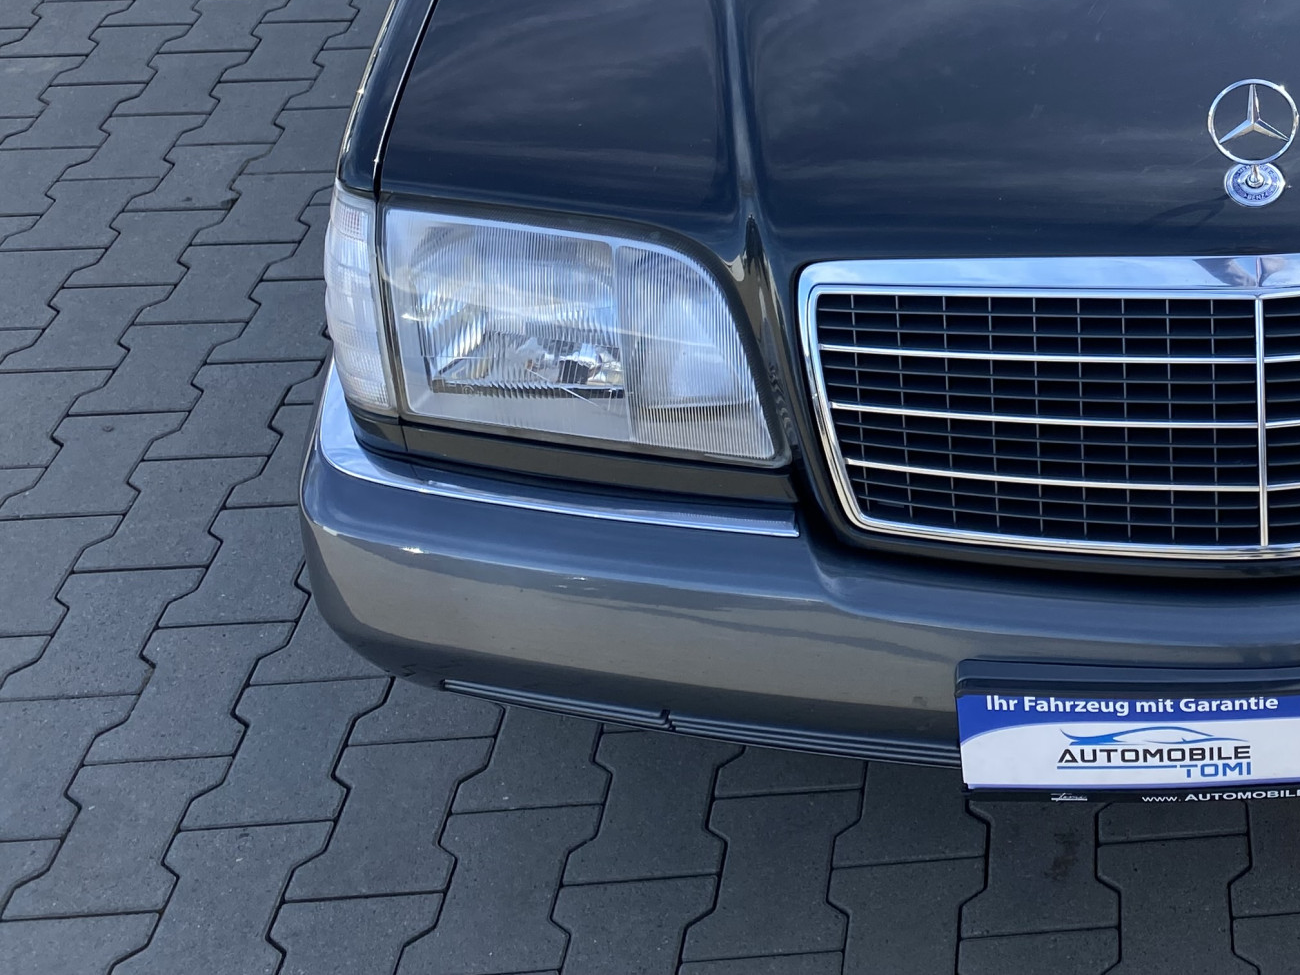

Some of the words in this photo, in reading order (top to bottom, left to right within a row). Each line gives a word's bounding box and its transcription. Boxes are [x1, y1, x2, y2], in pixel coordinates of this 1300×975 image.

[986, 695, 1018, 711] Ihr
[1023, 696, 1130, 716] Fahrzeug
[1136, 697, 1174, 712] mit
[1179, 696, 1279, 712] Garantie
[1058, 745, 1251, 764] AUTOMOBILE
[1179, 762, 1252, 778] TOMI
